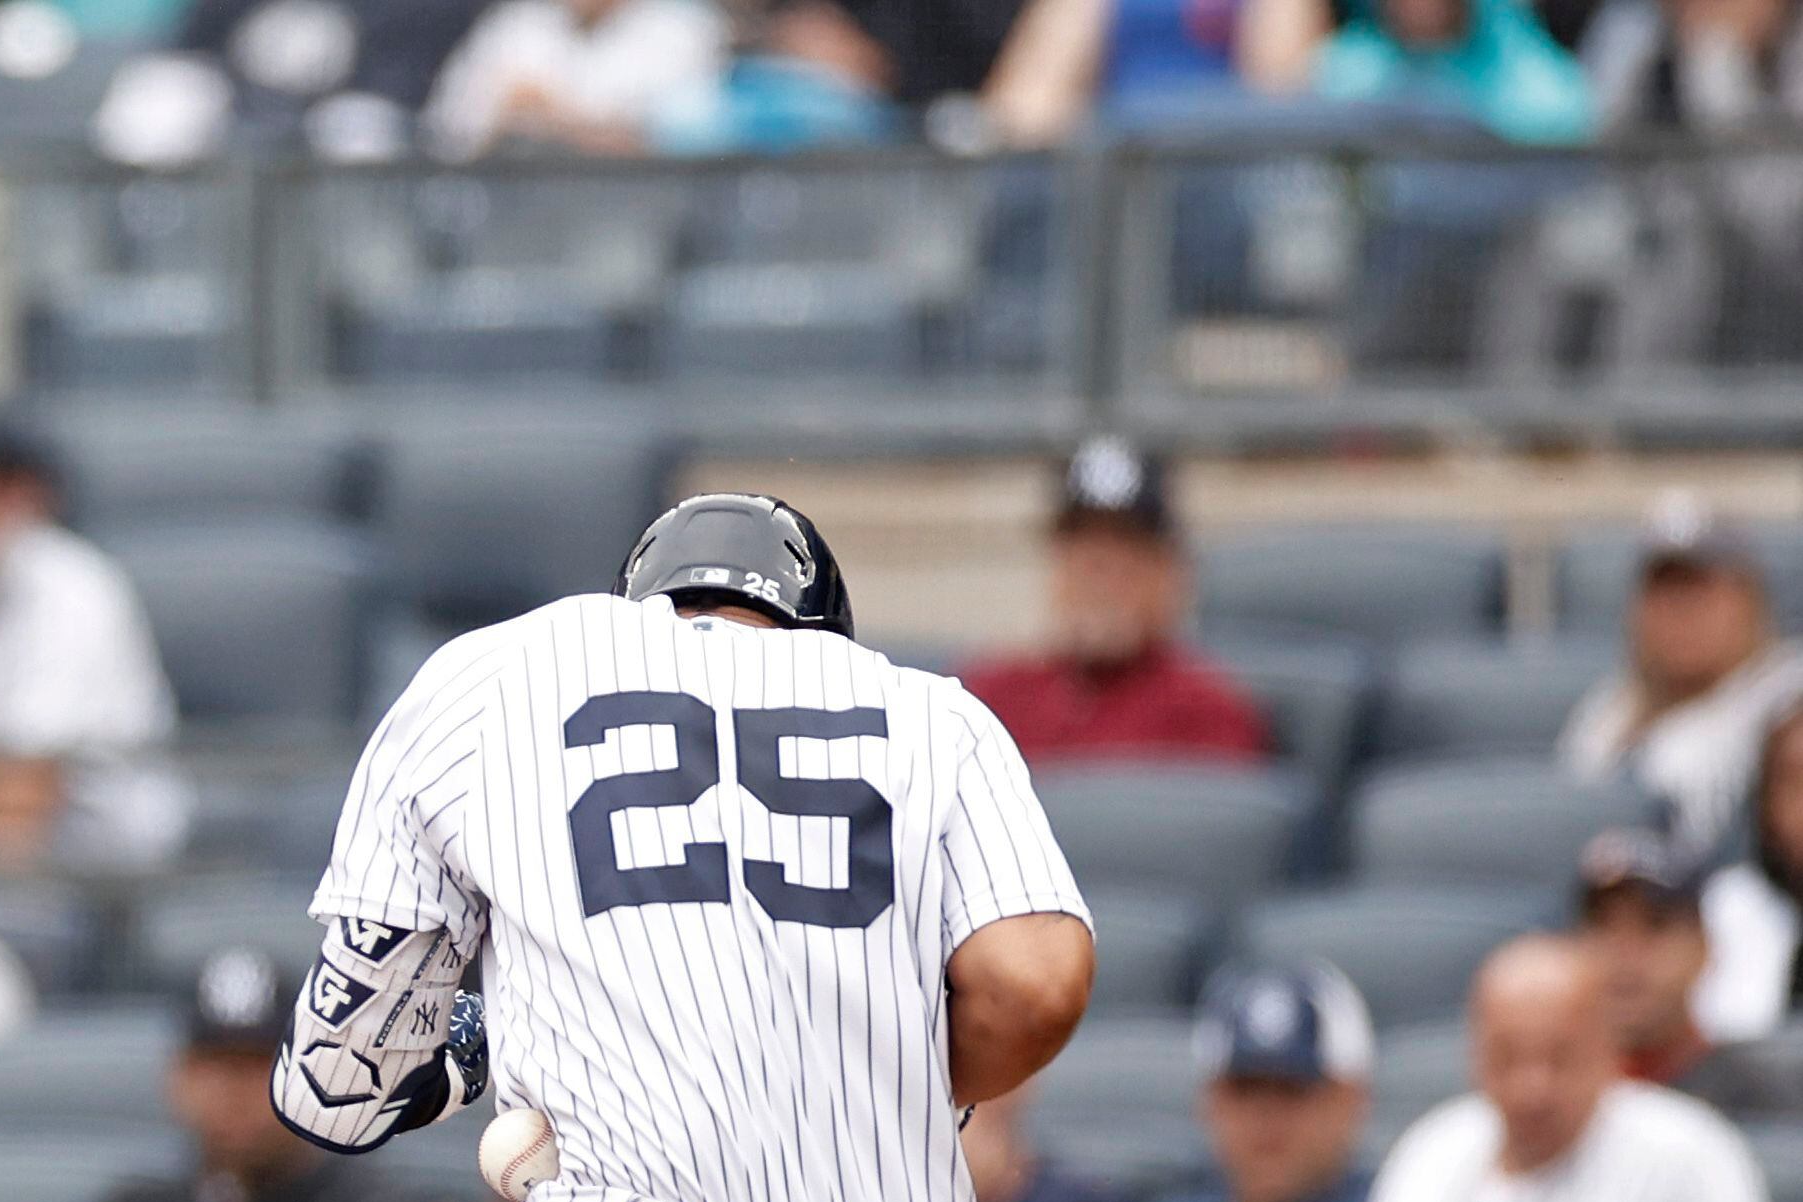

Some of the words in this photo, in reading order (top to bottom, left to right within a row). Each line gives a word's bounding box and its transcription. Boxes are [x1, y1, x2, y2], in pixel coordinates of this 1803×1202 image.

[742, 571, 780, 602] 25
[564, 690, 895, 929] 25
[410, 1001, 439, 1036] NY
